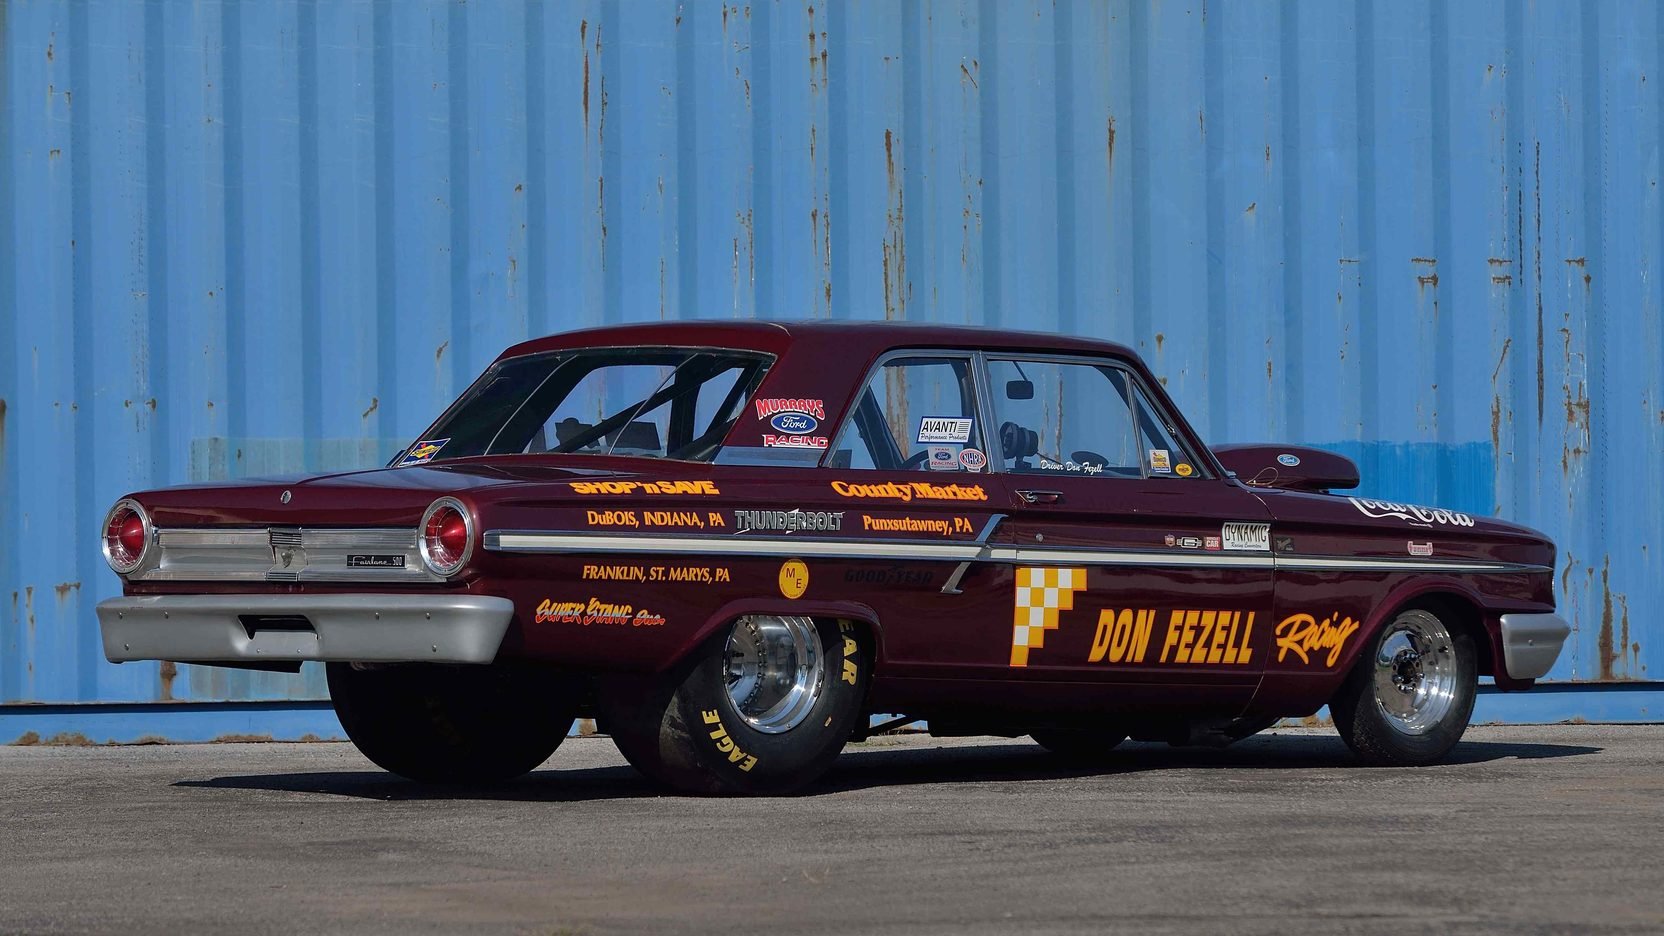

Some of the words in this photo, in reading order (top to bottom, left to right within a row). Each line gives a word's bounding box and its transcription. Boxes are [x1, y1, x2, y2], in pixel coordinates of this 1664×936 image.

[755, 398, 826, 420] MURRAYS
[781, 416, 808, 429] Ford
[921, 421, 958, 433] AVANTI
[762, 434, 829, 449] RACING
[920, 432, 947, 442] Performance
[948, 433, 967, 441] Products
[1040, 459, 1065, 471] Driver
[1065, 461, 1081, 471] Don
[1082, 461, 1103, 476] Fezell
[586, 510, 640, 528] DuBOIS,
[643, 511, 705, 529] INDIANA,
[708, 512, 725, 527] PA
[734, 508, 846, 533] THUNDERBOLT
[862, 515, 953, 536] Punxsutawney,
[953, 517, 974, 533] PA
[1224, 523, 1270, 543] DYNAMIC
[1206, 540, 1219, 548] CAR
[348, 556, 388, 567] Fairlane
[392, 556, 403, 566] 500
[582, 565, 647, 583] FRANKLIN,
[649, 566, 666, 581] ST.
[668, 567, 713, 584] MARYS,
[715, 568, 731, 582] PA
[786, 567, 796, 578] M
[796, 578, 802, 589] E
[535, 598, 586, 624] SUPER
[1087, 608, 1156, 664] DON
[1159, 609, 1256, 664] FEZELL
[1275, 611, 1360, 668] Racing
[701, 708, 759, 773] EAGLE
